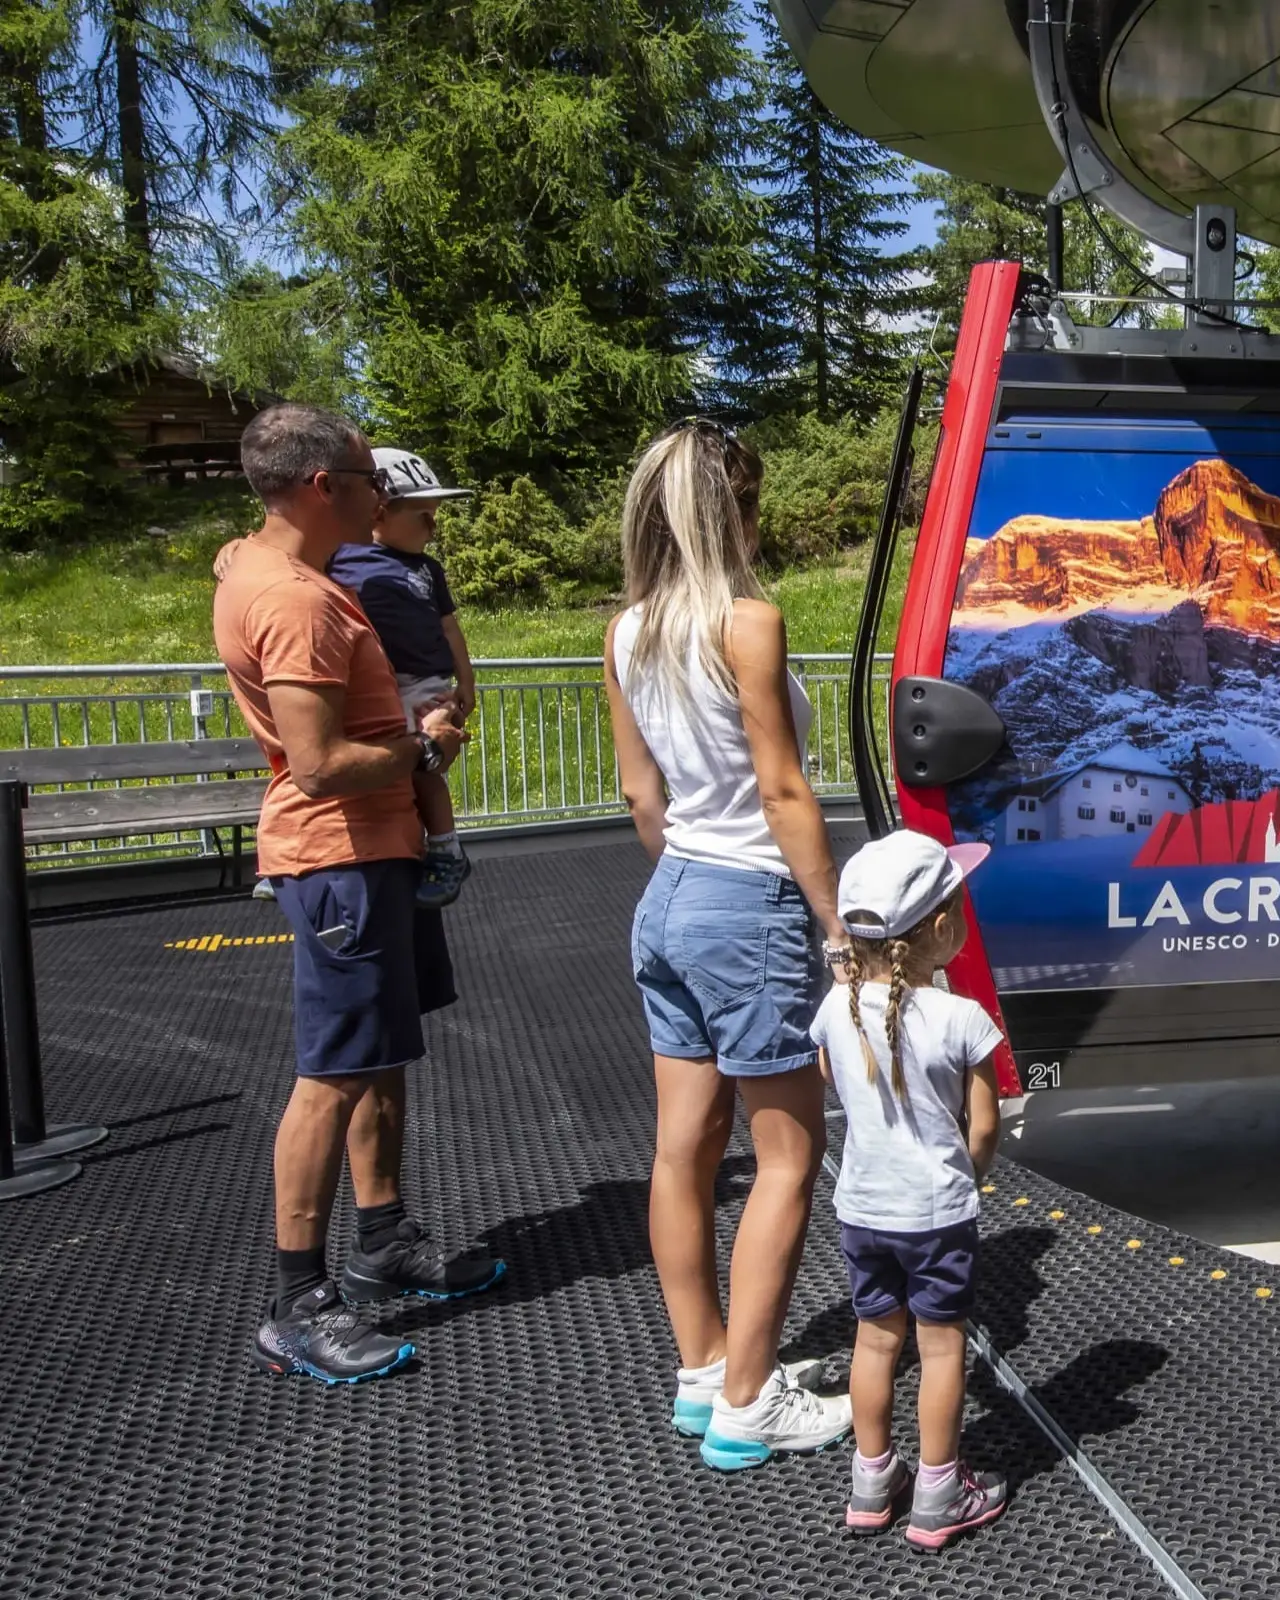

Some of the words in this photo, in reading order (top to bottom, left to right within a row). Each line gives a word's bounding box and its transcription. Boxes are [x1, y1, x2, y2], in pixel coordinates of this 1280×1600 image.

[1107, 880, 1191, 928] LA
[1162, 934, 1248, 952] UNESCO
[1028, 1061, 1061, 1090] 21
